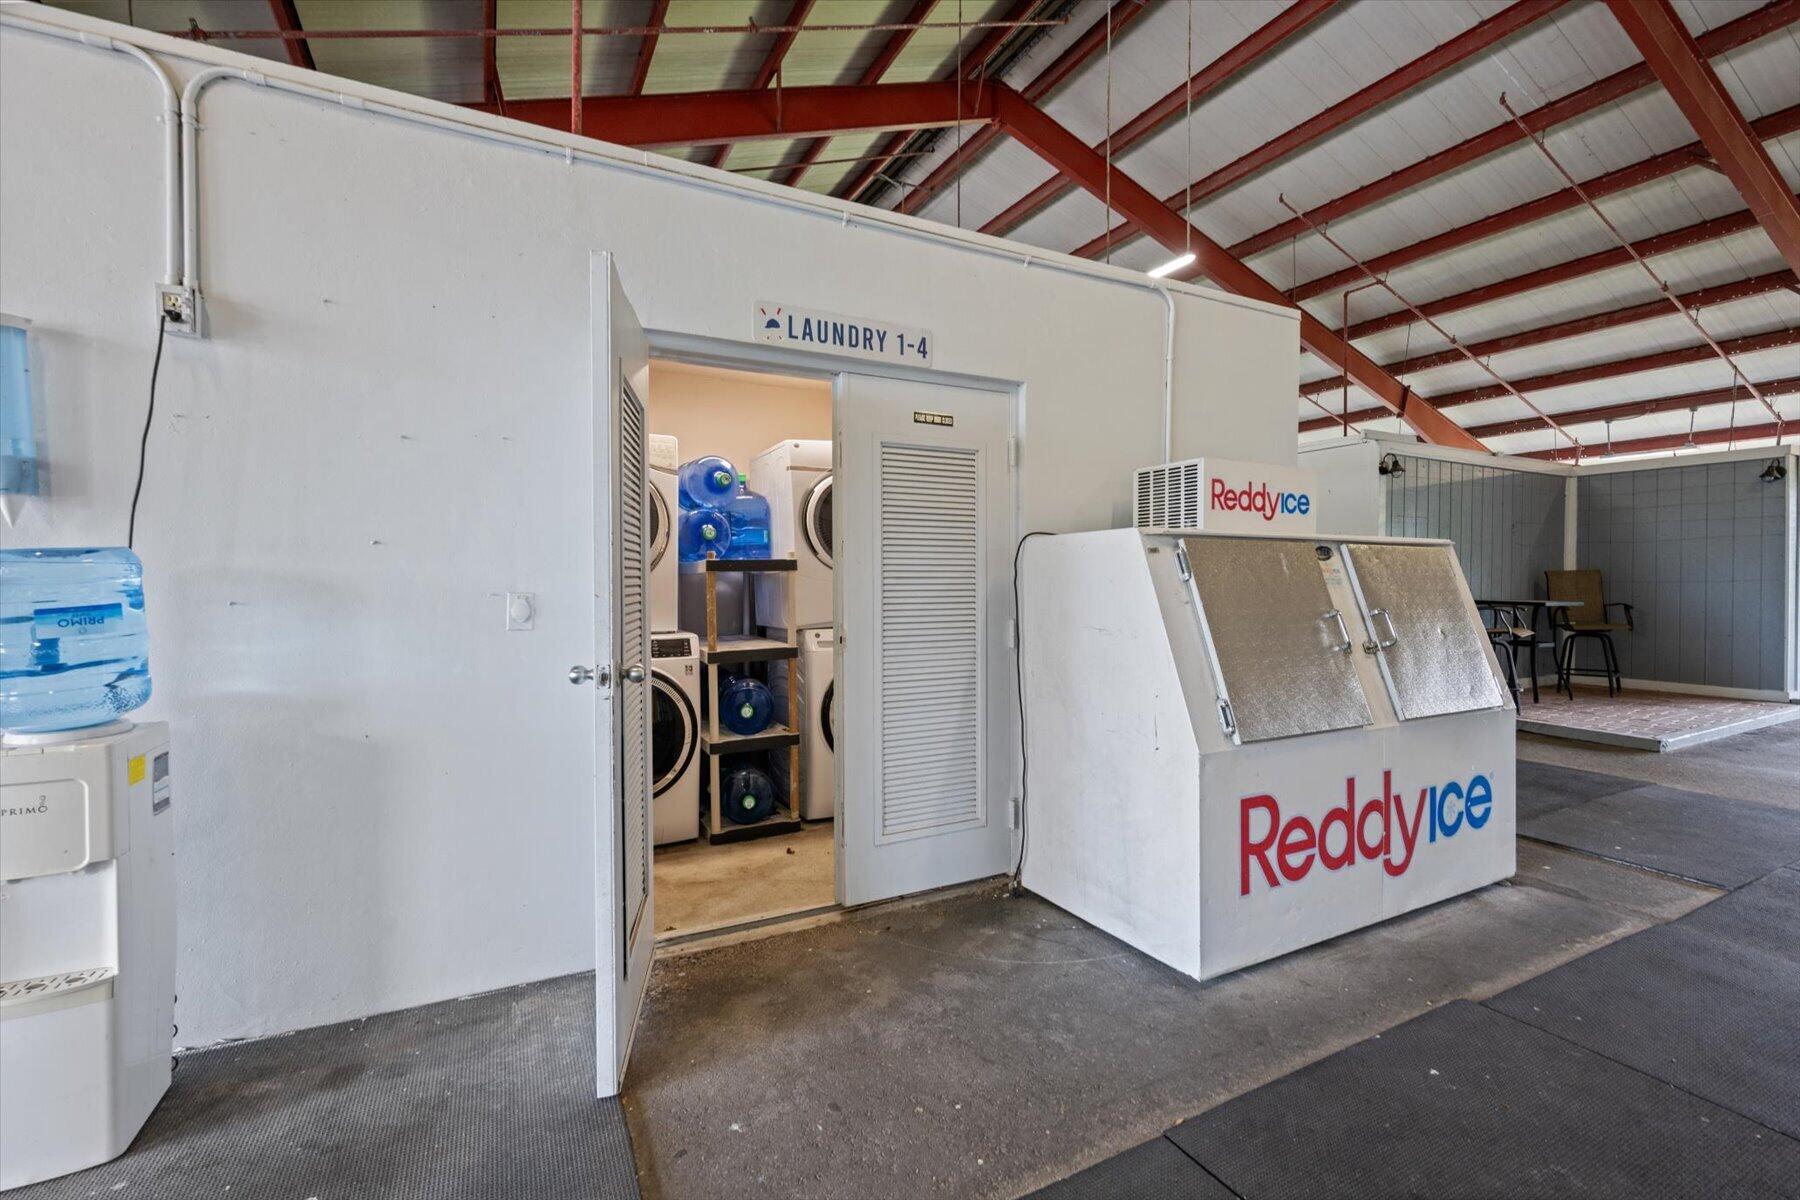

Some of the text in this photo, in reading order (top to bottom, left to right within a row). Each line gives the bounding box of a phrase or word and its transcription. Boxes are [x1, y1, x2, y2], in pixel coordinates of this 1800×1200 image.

[788, 315, 928, 359] LAUNDRY 1-4
[57, 616, 105, 628] PRIMO
[1, 805, 48, 816] PRIMO
